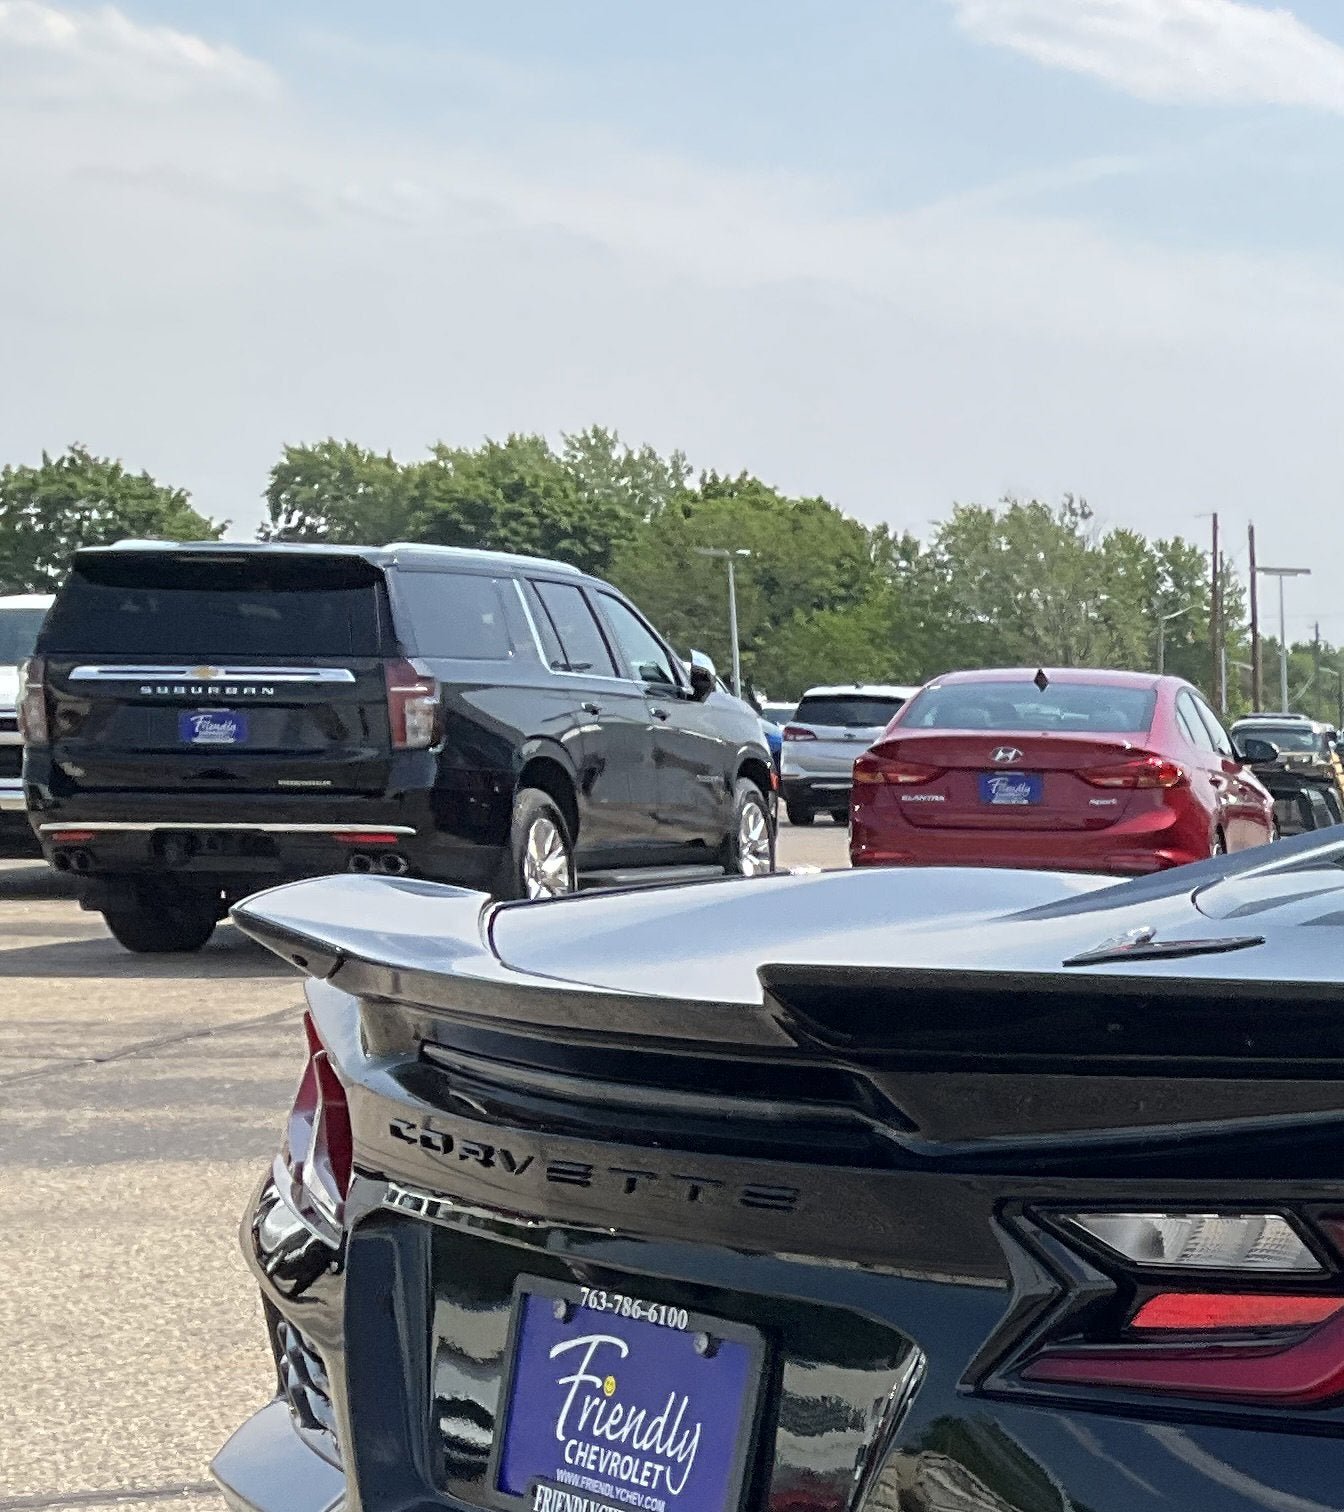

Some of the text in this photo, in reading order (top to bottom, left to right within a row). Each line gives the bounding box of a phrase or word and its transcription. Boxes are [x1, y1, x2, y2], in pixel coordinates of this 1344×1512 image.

[140, 685, 274, 695] SUBURBAN
[389, 1117, 799, 1212] CORVETTE
[580, 1287, 689, 1330] 763-786-6100
[549, 1334, 702, 1495] Friendly
[564, 1439, 665, 1490] CHEVROLET
